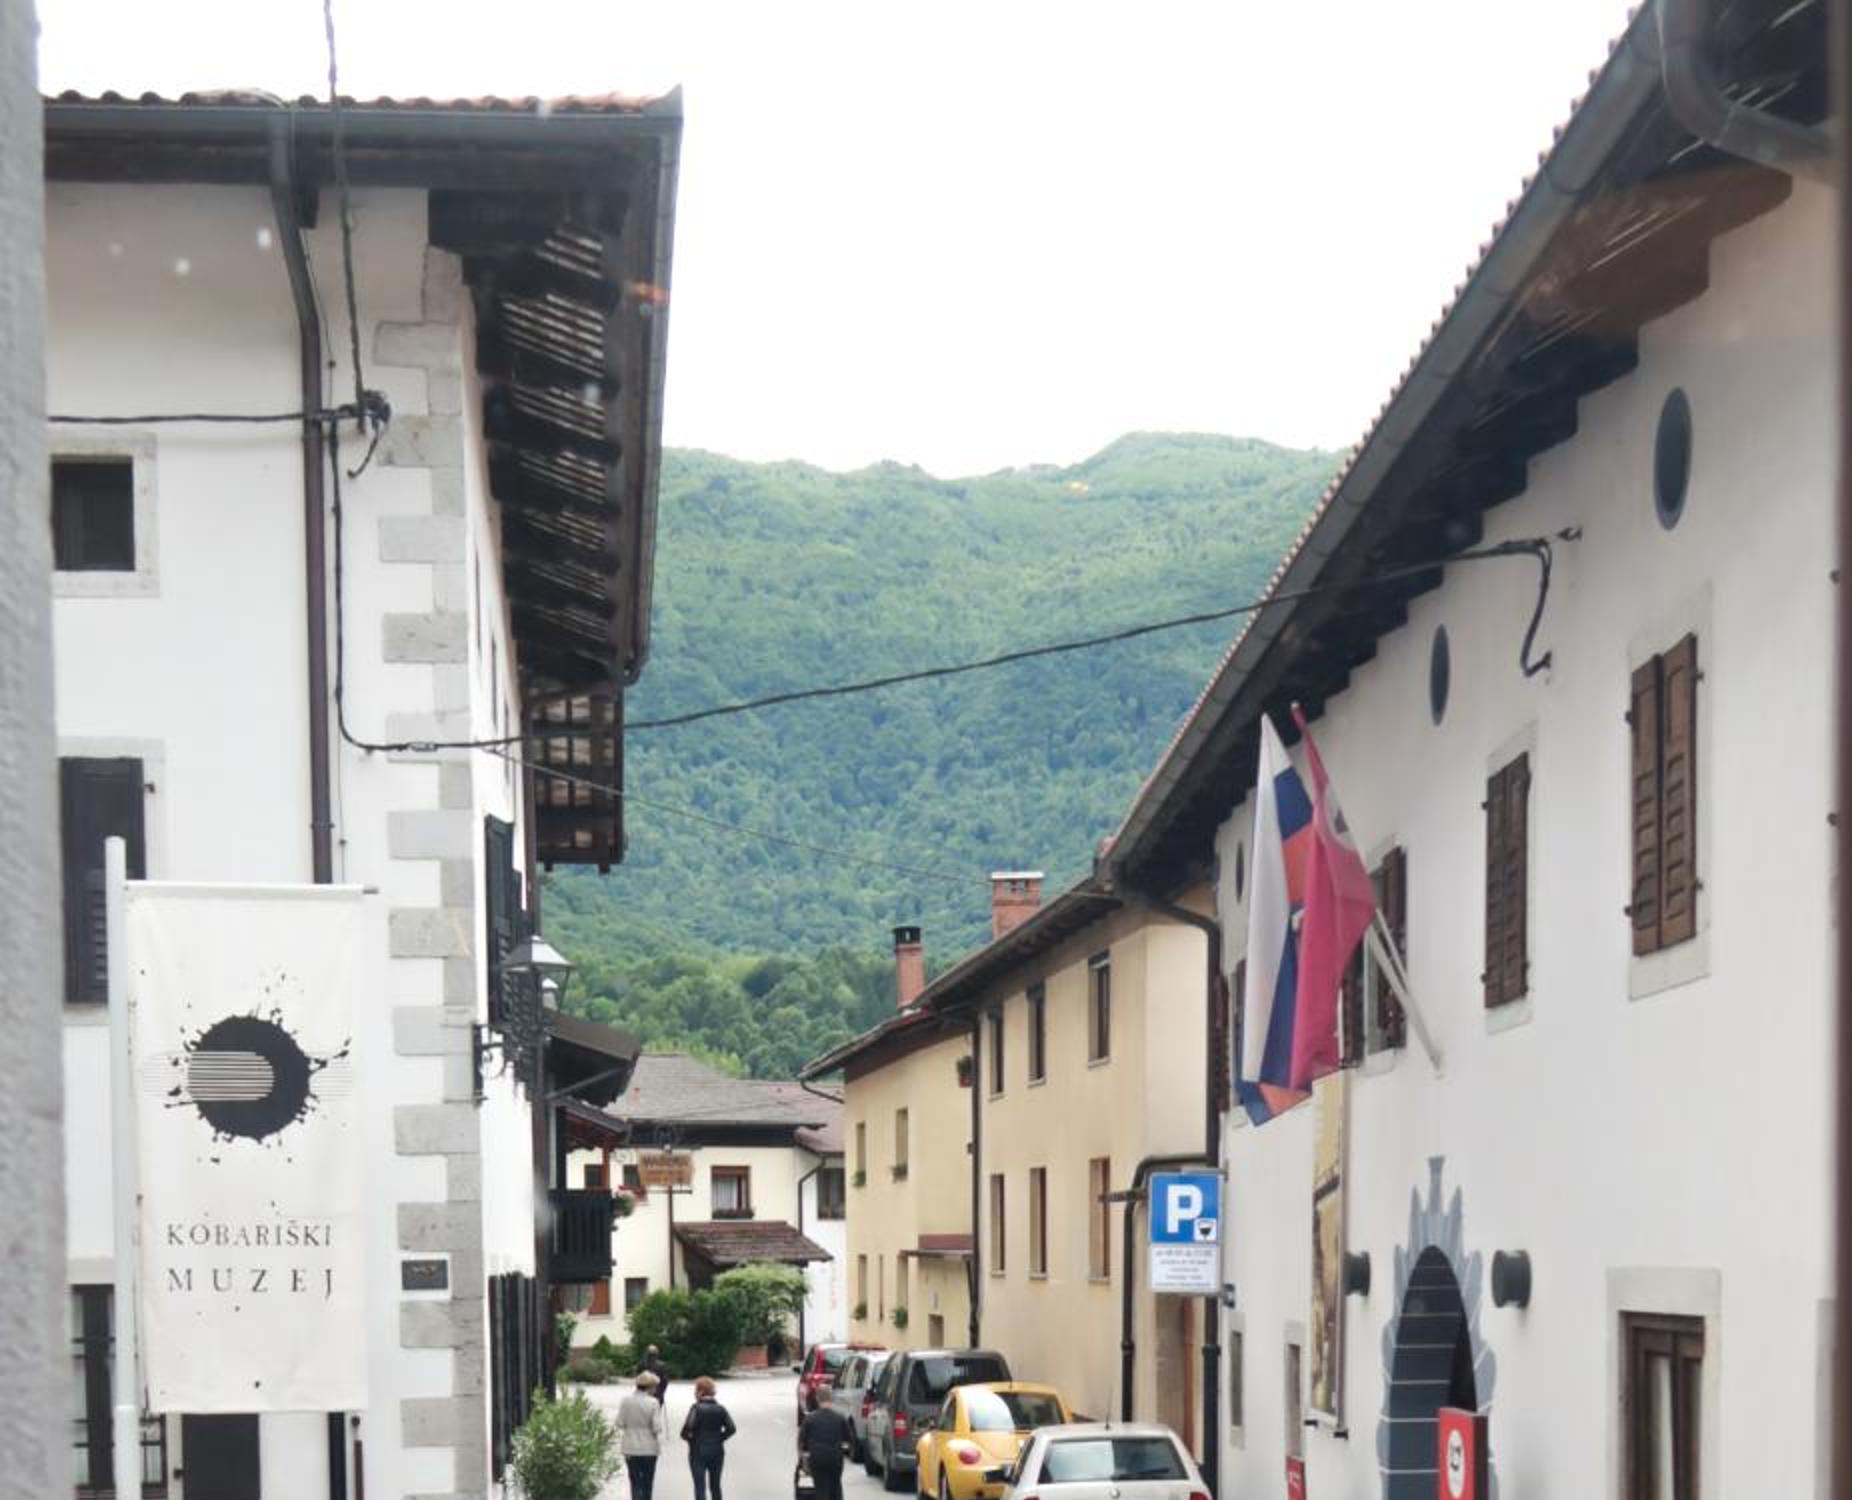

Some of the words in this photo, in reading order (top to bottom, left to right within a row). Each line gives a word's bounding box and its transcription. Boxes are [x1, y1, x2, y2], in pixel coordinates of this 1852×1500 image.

[1167, 1183, 1203, 1233] P
[167, 1219, 331, 1246] KOBARIŠKI
[168, 1268, 332, 1300] MUZEJ
